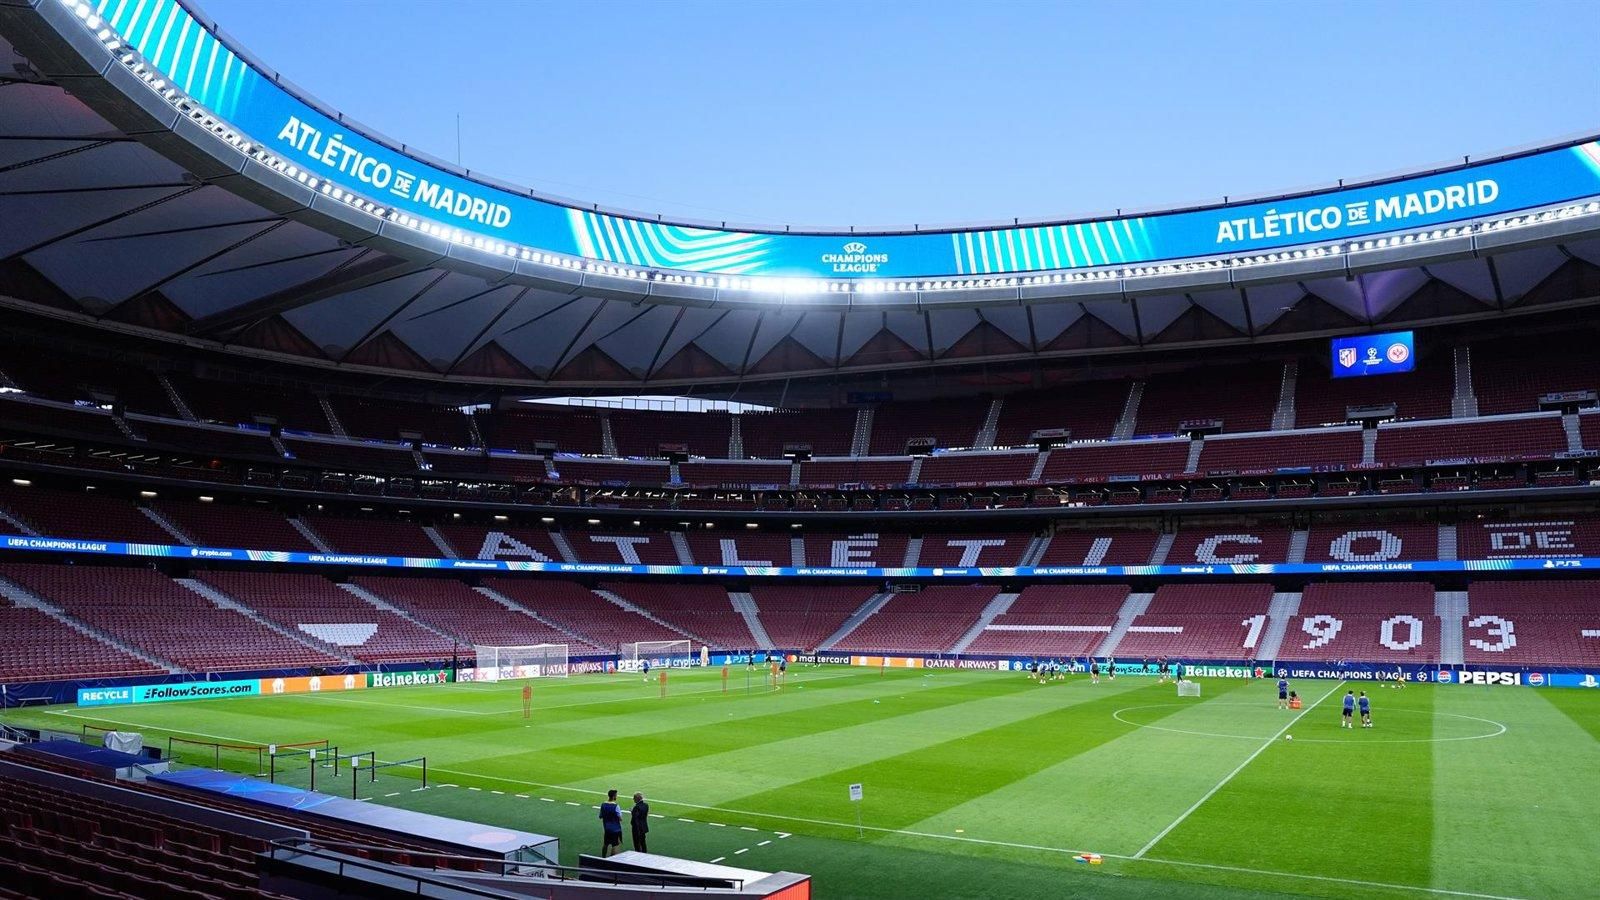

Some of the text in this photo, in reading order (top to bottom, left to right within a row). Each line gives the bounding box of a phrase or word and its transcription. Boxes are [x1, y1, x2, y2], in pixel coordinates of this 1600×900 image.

[277, 115, 512, 228] ATLÉTICO DE MADRID
[1216, 179, 1499, 243] ATLÉTICO DE MADRID
[821, 254, 888, 263] CHAMPIONS
[833, 263, 877, 272] LEAGUE
[8, 538, 107, 551] UEFA CHAMPIONS LEAGUE
[1490, 530, 1575, 550] DE
[199, 549, 233, 558] crypto.com
[326, 556, 363, 564] CHAMPIONS
[363, 557, 388, 565] LEAGUE
[799, 655, 849, 664] masercard
[926, 659, 996, 670] QATAR AIRWAYS
[498, 667, 526, 679] FedEx
[542, 662, 603, 675] QATAR AIRWAYS
[1184, 665, 1252, 678] Heineken
[1292, 670, 1315, 678] UEFA
[373, 671, 437, 687] Heineken
[457, 668, 488, 682] FedEx
[1458, 670, 1521, 685] PEPSI
[83, 690, 129, 700] RECYCLE
